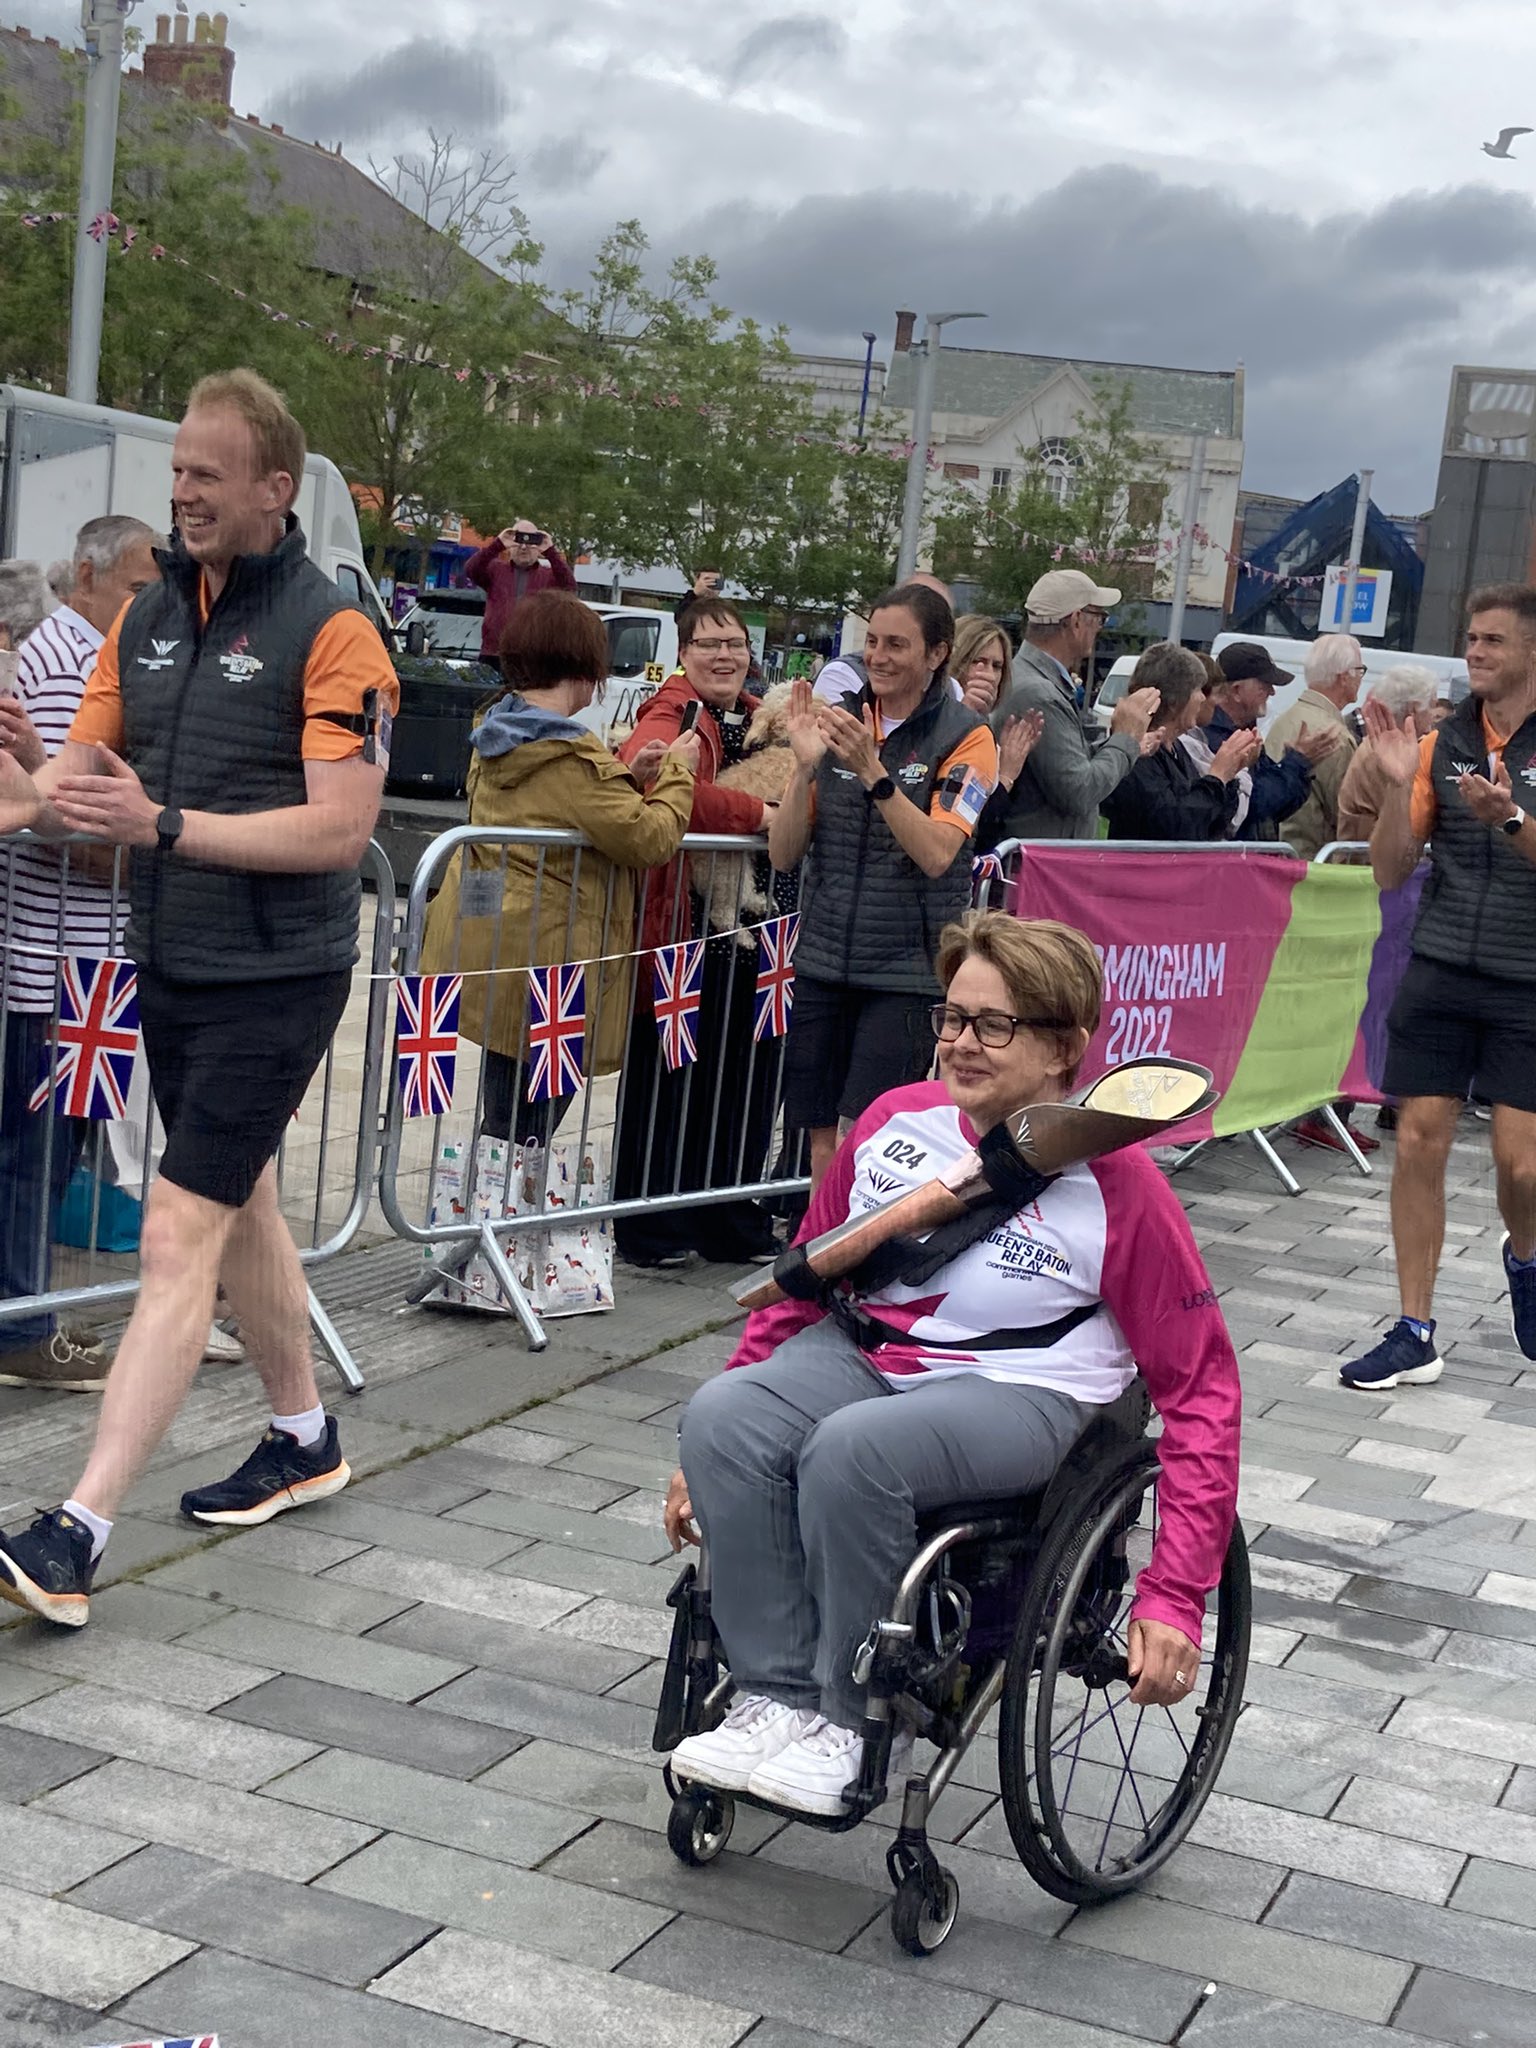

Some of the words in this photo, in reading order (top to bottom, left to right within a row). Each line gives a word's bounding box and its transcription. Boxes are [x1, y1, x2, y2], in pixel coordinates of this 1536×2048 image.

[647, 666, 664, 683] £5
[1094, 942, 1227, 1002] MINGHAM
[1105, 1005, 1173, 1065] 2022
[882, 1139, 928, 1170] 024
[1001, 1249, 1044, 1273] RELAY
[1034, 1248, 1073, 1276] BATON
[1001, 1271, 1033, 1282] games
